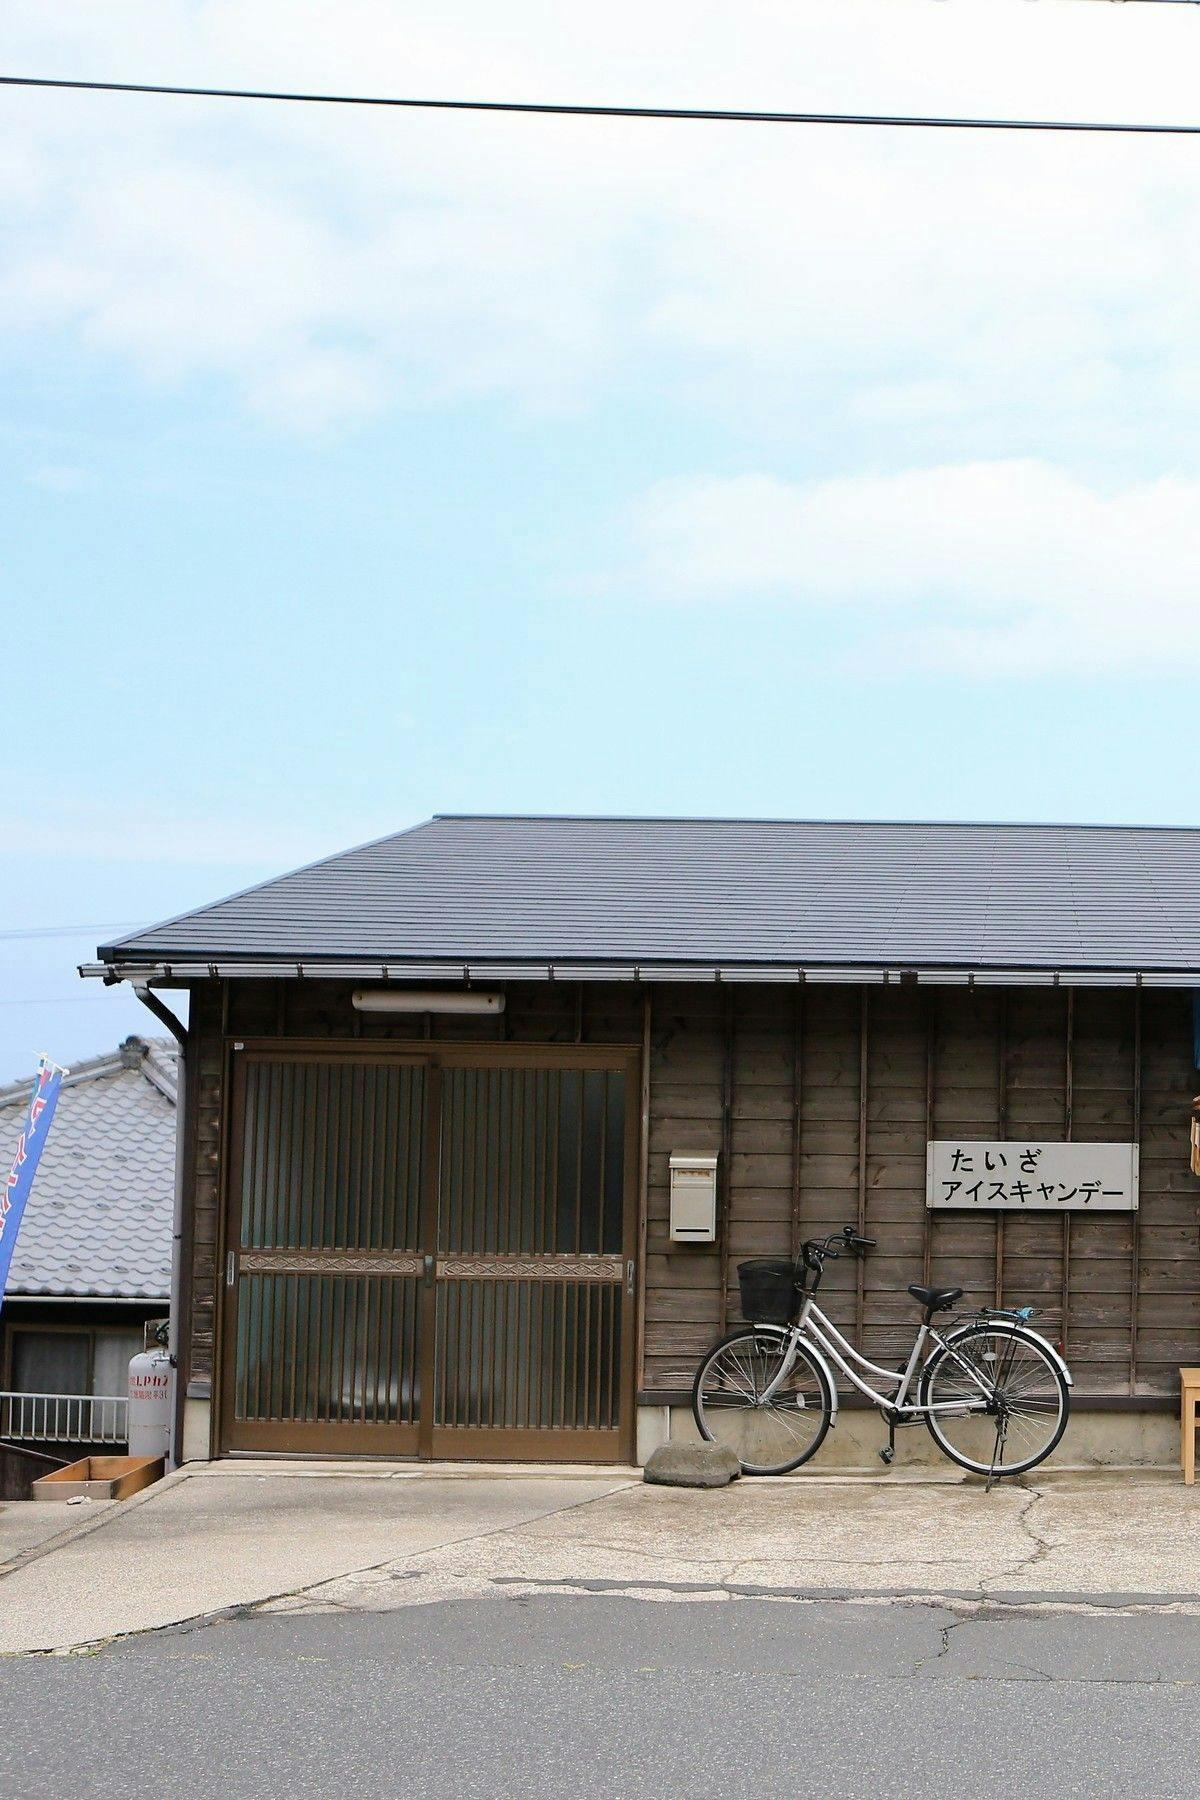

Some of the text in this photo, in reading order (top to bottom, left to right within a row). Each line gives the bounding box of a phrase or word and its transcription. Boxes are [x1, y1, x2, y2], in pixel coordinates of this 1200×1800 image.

[951, 1149, 1042, 1173] たいざ
[942, 1180, 1123, 1204] アイスキャンデー
